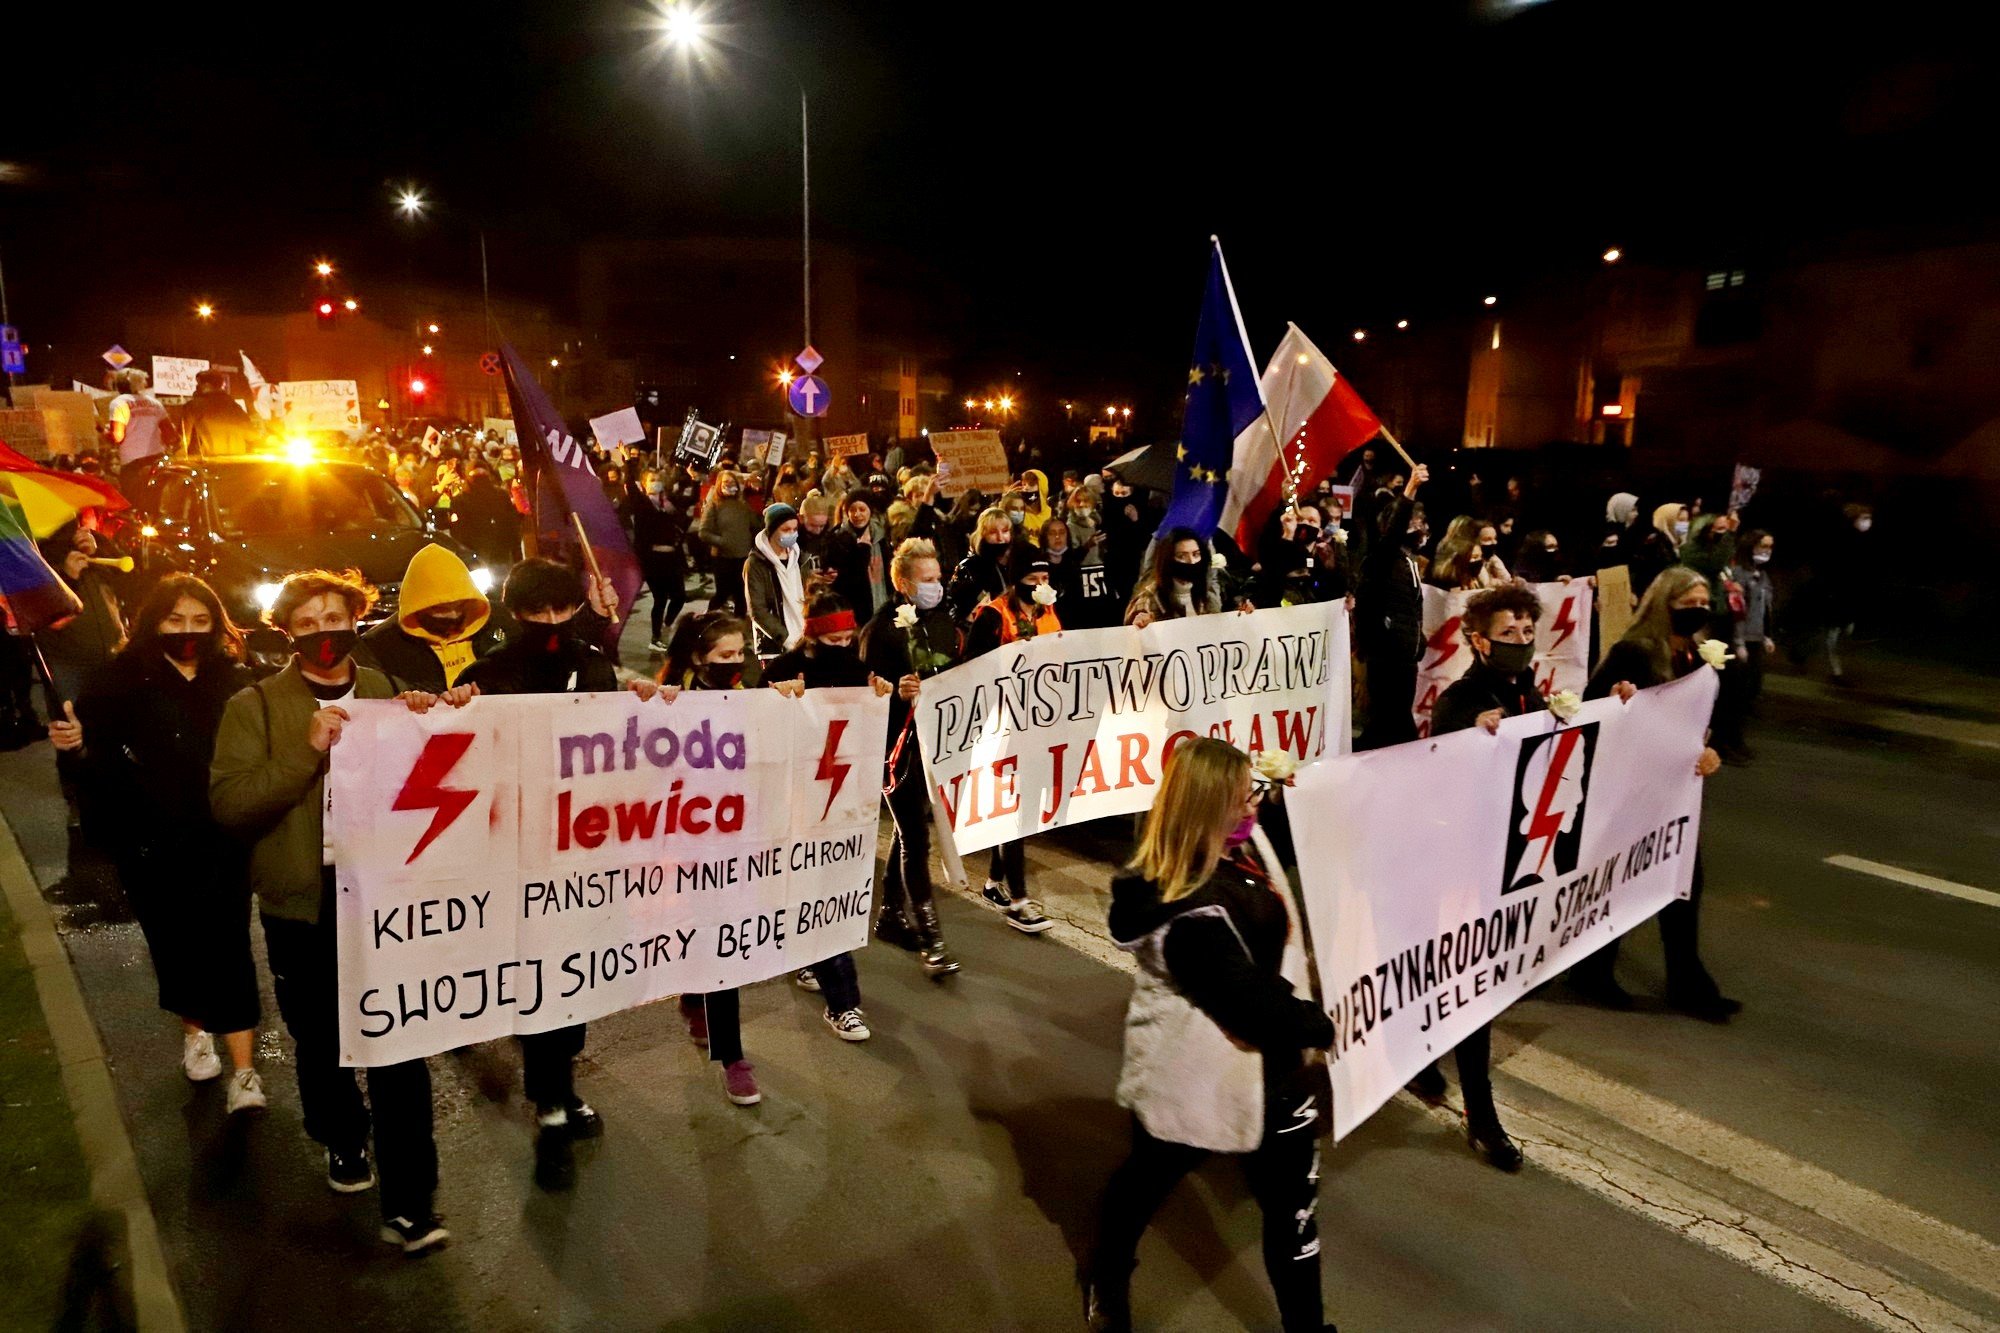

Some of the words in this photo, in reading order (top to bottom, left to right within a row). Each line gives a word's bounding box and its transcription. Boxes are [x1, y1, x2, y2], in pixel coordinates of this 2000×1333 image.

[559, 715, 746, 779] młoda
[933, 647, 1195, 765] PAŃSTWO
[556, 780, 746, 852] lewica
[937, 754, 1021, 833] NIE
[373, 890, 491, 950] KIEDY
[524, 864, 664, 919] PAŃSTWO
[676, 856, 738, 894] MNIE
[748, 846, 783, 881] NIE
[1550, 852, 1620, 933] STRAJK
[1622, 815, 1690, 884] KOBIET
[359, 958, 544, 1039] SWOJEJ
[560, 928, 697, 998] SIOSTRY
[716, 909, 786, 960] BĘDĘ
[796, 877, 872, 935] BRONIĆ
[1420, 950, 1546, 1033] JELENIA
[1559, 899, 1611, 949] GÓRA
